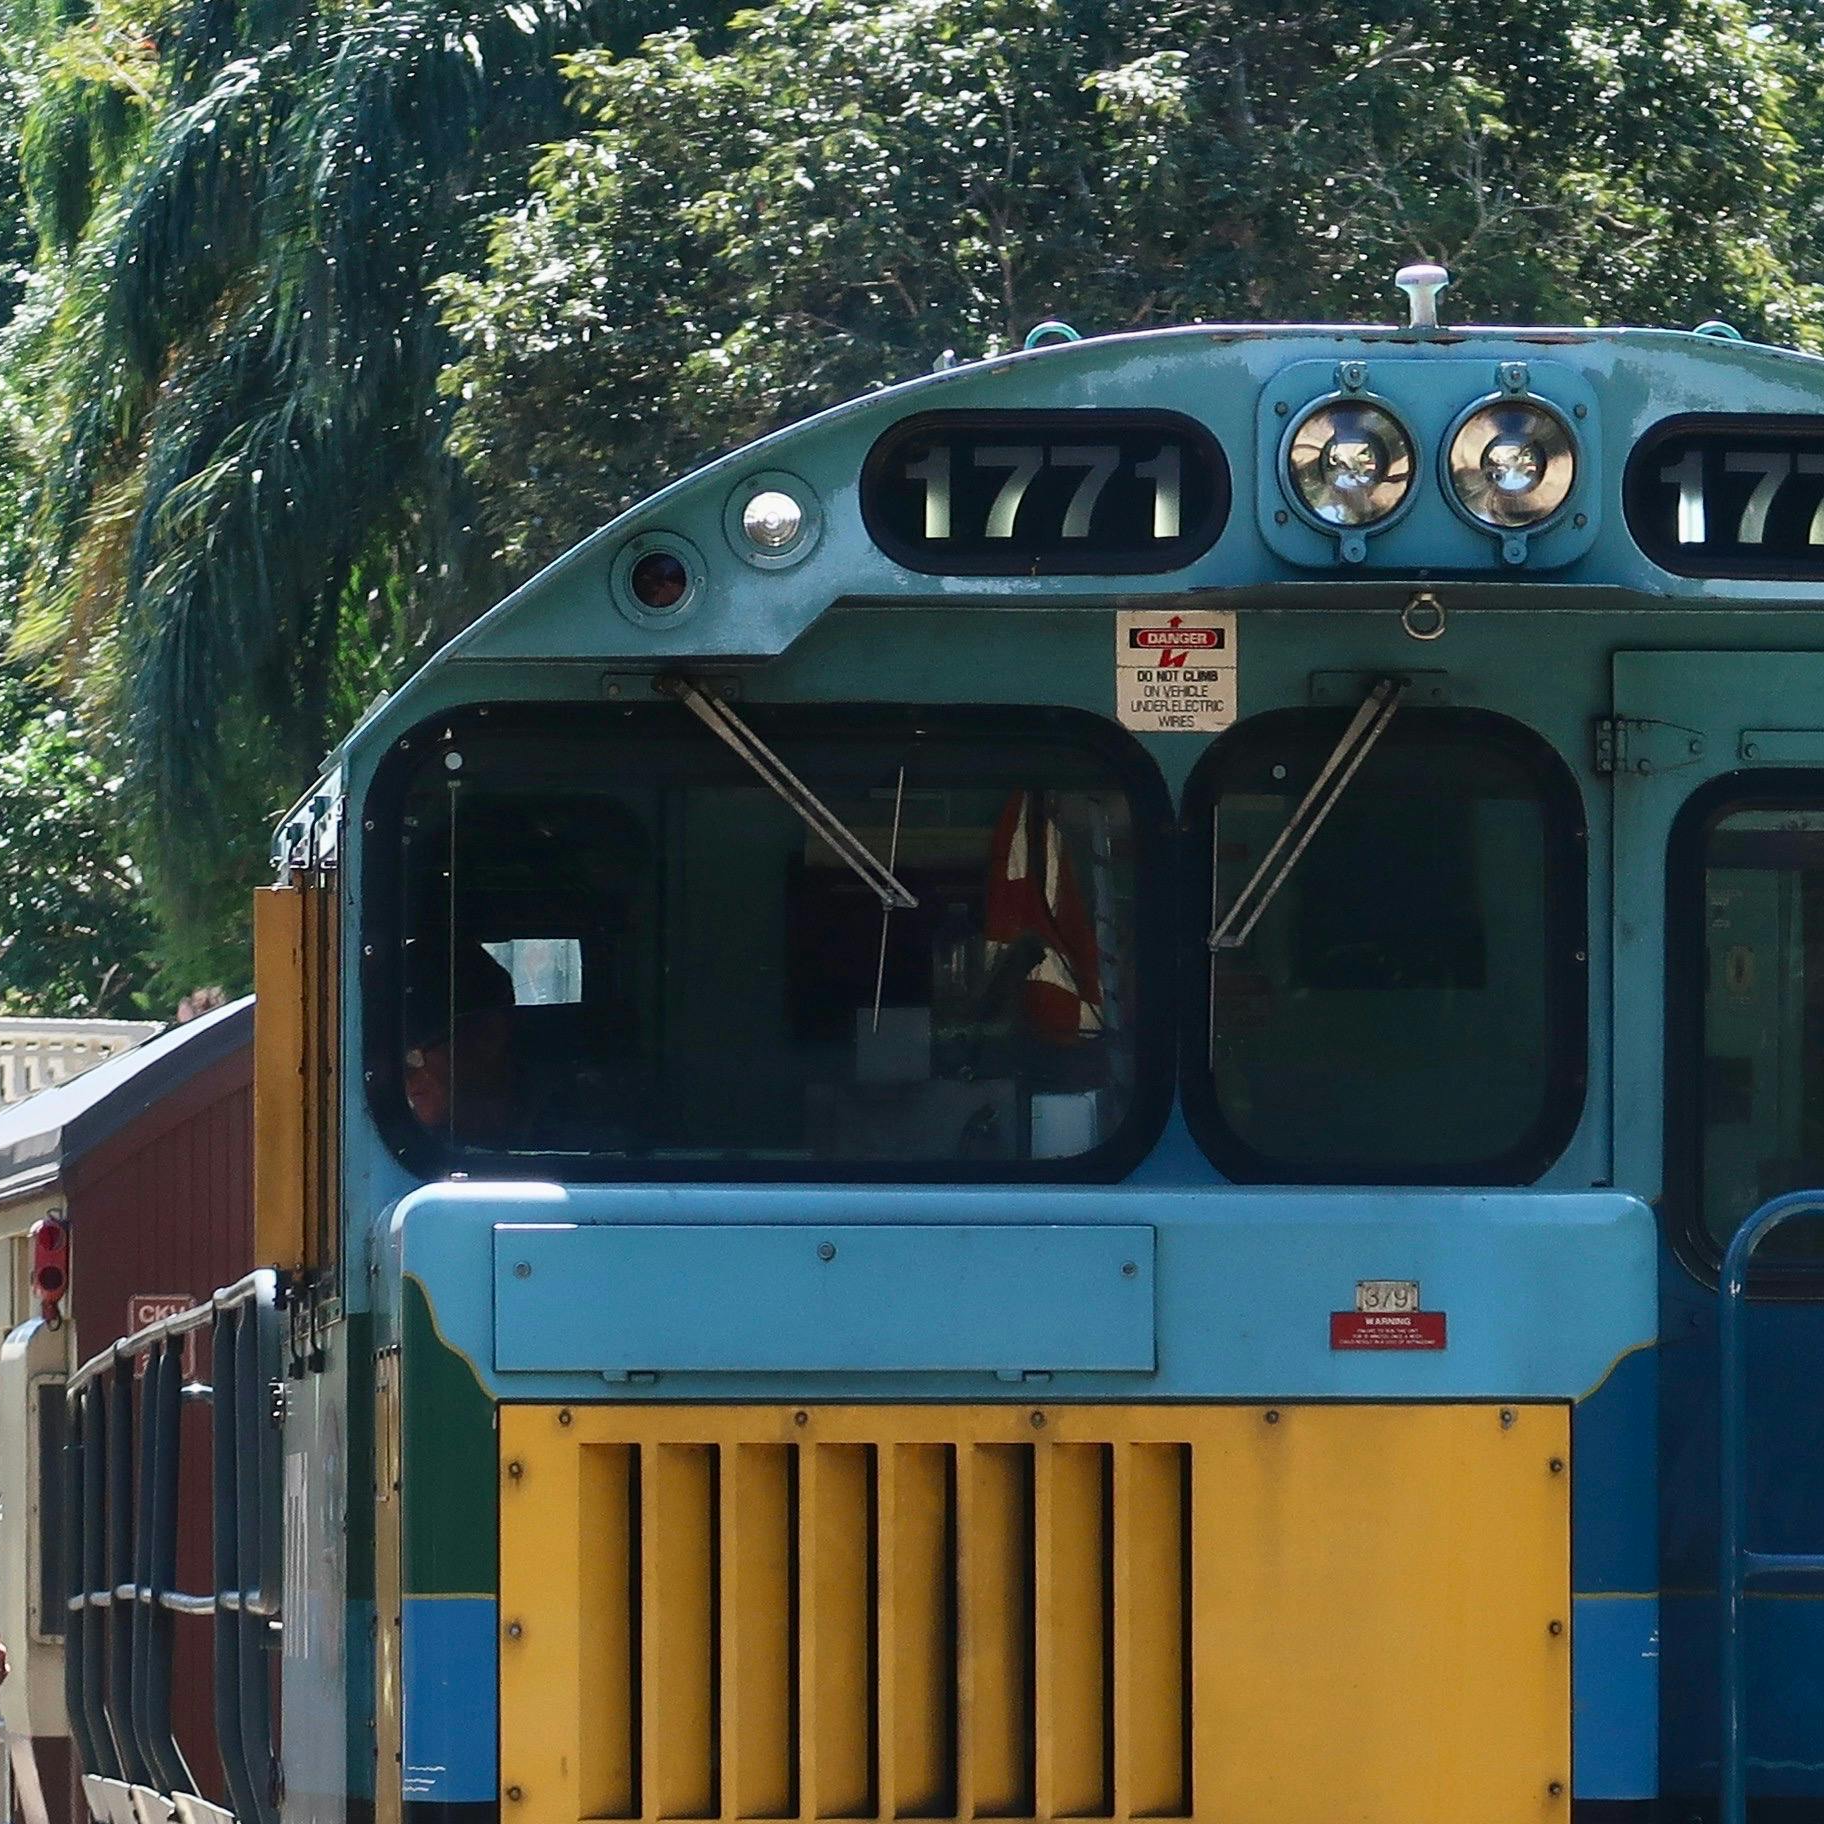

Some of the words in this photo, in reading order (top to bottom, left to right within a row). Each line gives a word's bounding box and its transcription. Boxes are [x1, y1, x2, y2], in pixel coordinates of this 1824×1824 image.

[905, 445, 1182, 539] 1771
[1147, 632, 1208, 645] DANGER
[1137, 670, 1153, 682] DO
[1157, 670, 1179, 682] NOT
[1183, 670, 1218, 682] CLIMB
[1144, 685, 1160, 698] ON
[1163, 685, 1209, 698] VEHICLE
[1131, 700, 1170, 712] UNDER
[1172, 700, 1225, 712] ELECTRIC
[1158, 715, 1195, 728] WIRES
[1365, 1317, 1412, 1326] WARNING
